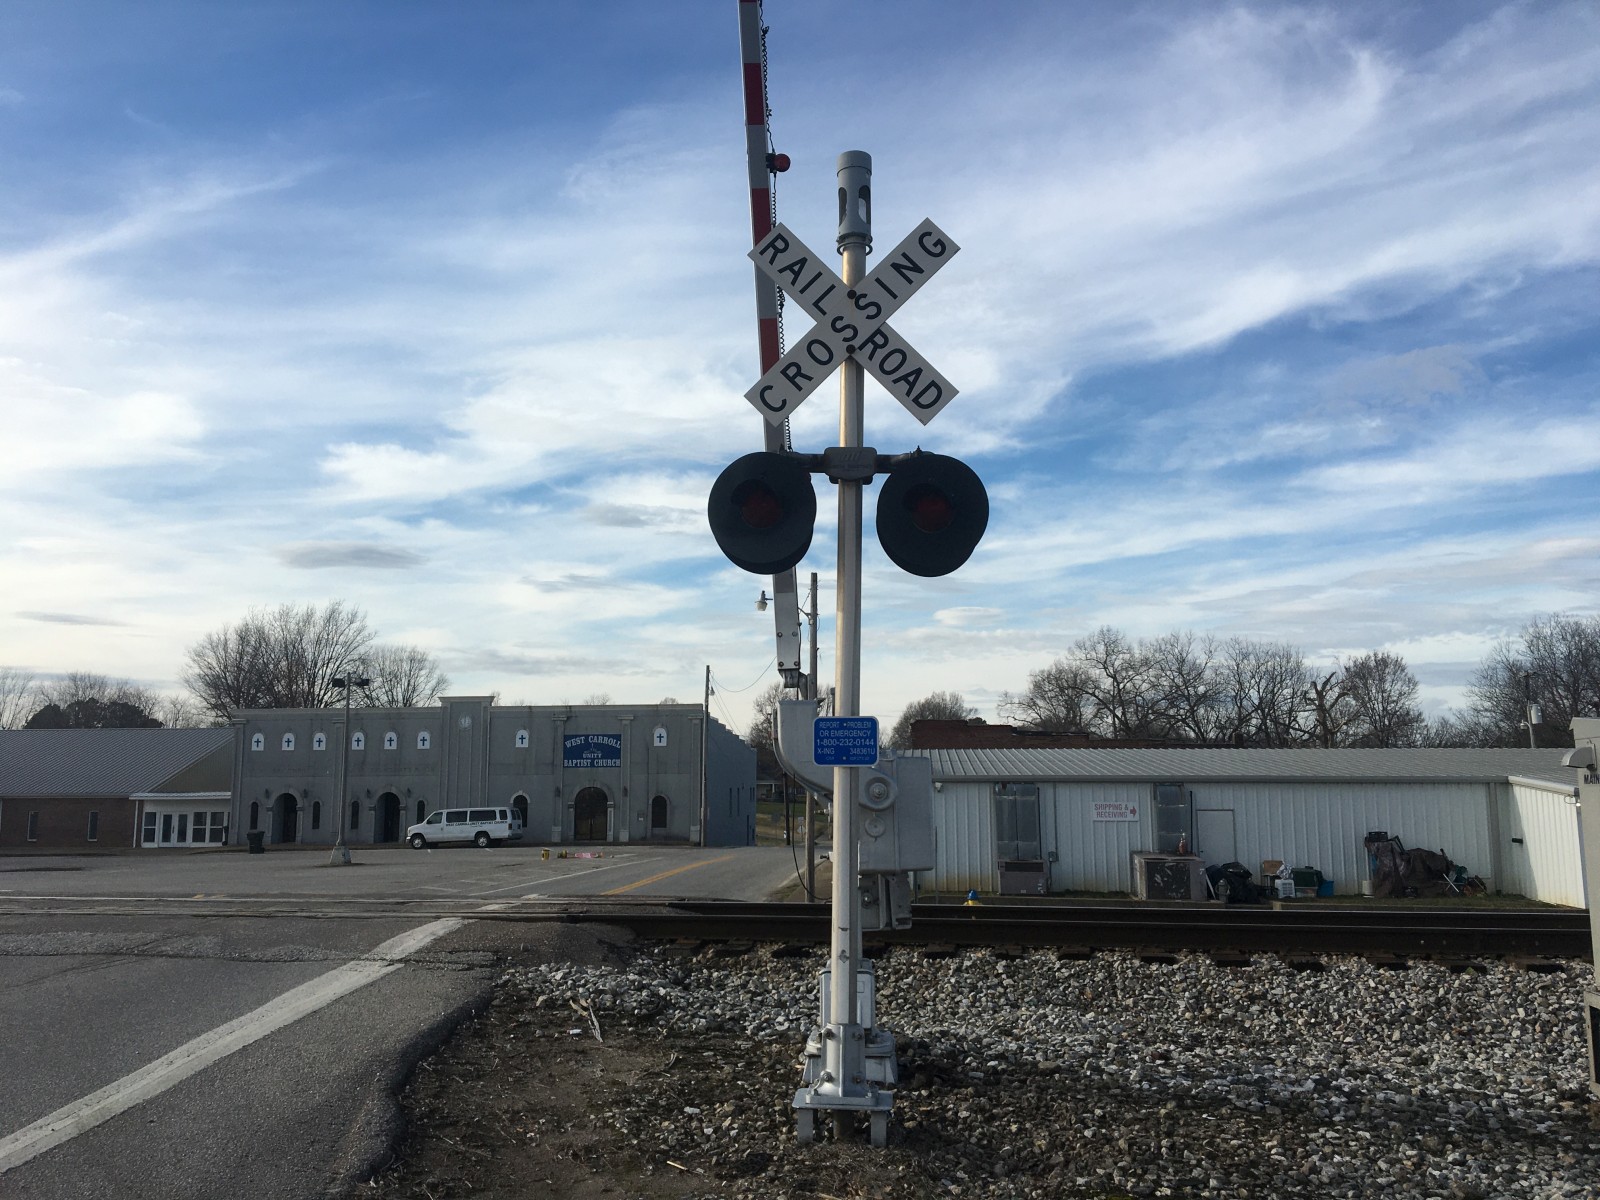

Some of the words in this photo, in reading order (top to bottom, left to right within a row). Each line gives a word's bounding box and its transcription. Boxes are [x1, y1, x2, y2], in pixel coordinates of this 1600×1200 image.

[758, 232, 837, 316] RAIL
[857, 328, 943, 410] ROAD
[759, 231, 947, 413] CROSSING
[565, 736, 585, 748] WEST
[588, 736, 620, 748] CARROLL
[816, 738, 874, 746] 1-800-232-0144
[817, 747, 835, 755] X-ING
[564, 759, 591, 767] BAPTIST
[594, 759, 620, 767] CHURCH
[1124, 803, 1129, 811] &
[1096, 811, 1128, 819] RECEIVING
